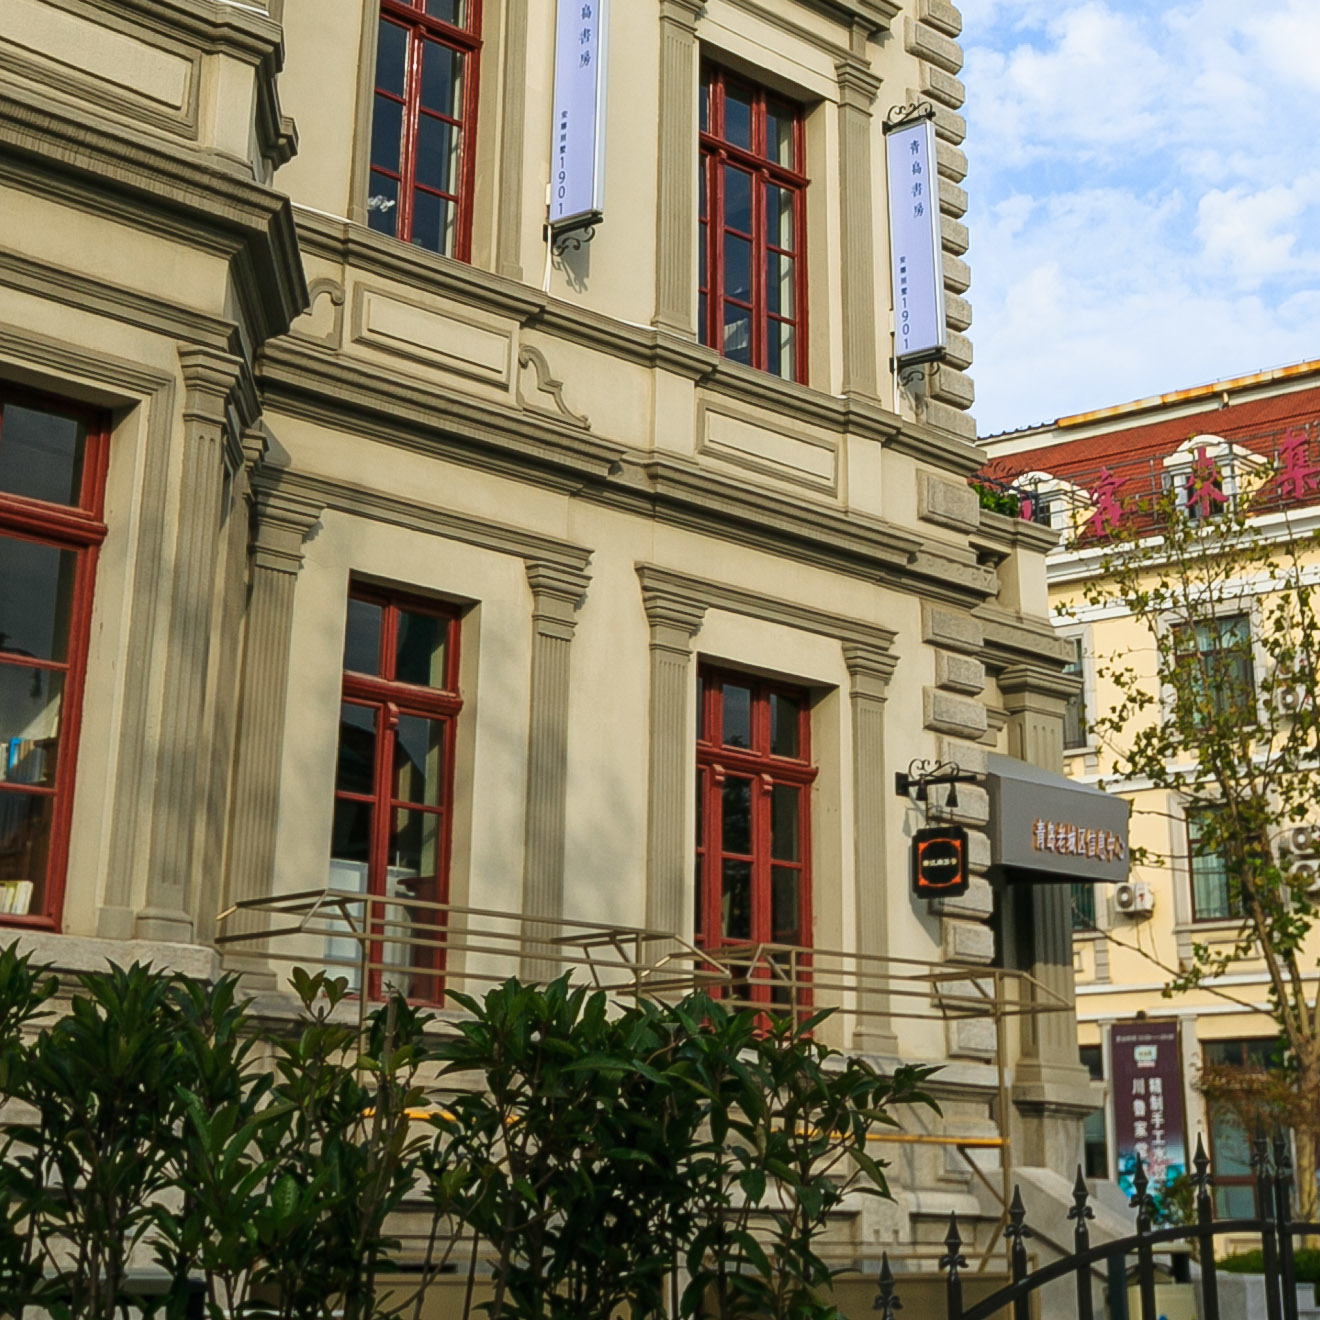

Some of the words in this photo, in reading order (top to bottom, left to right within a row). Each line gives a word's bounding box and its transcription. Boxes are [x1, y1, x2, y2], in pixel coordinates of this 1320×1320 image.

[1034, 817, 1126, 864] 青岛老城区信息中心
